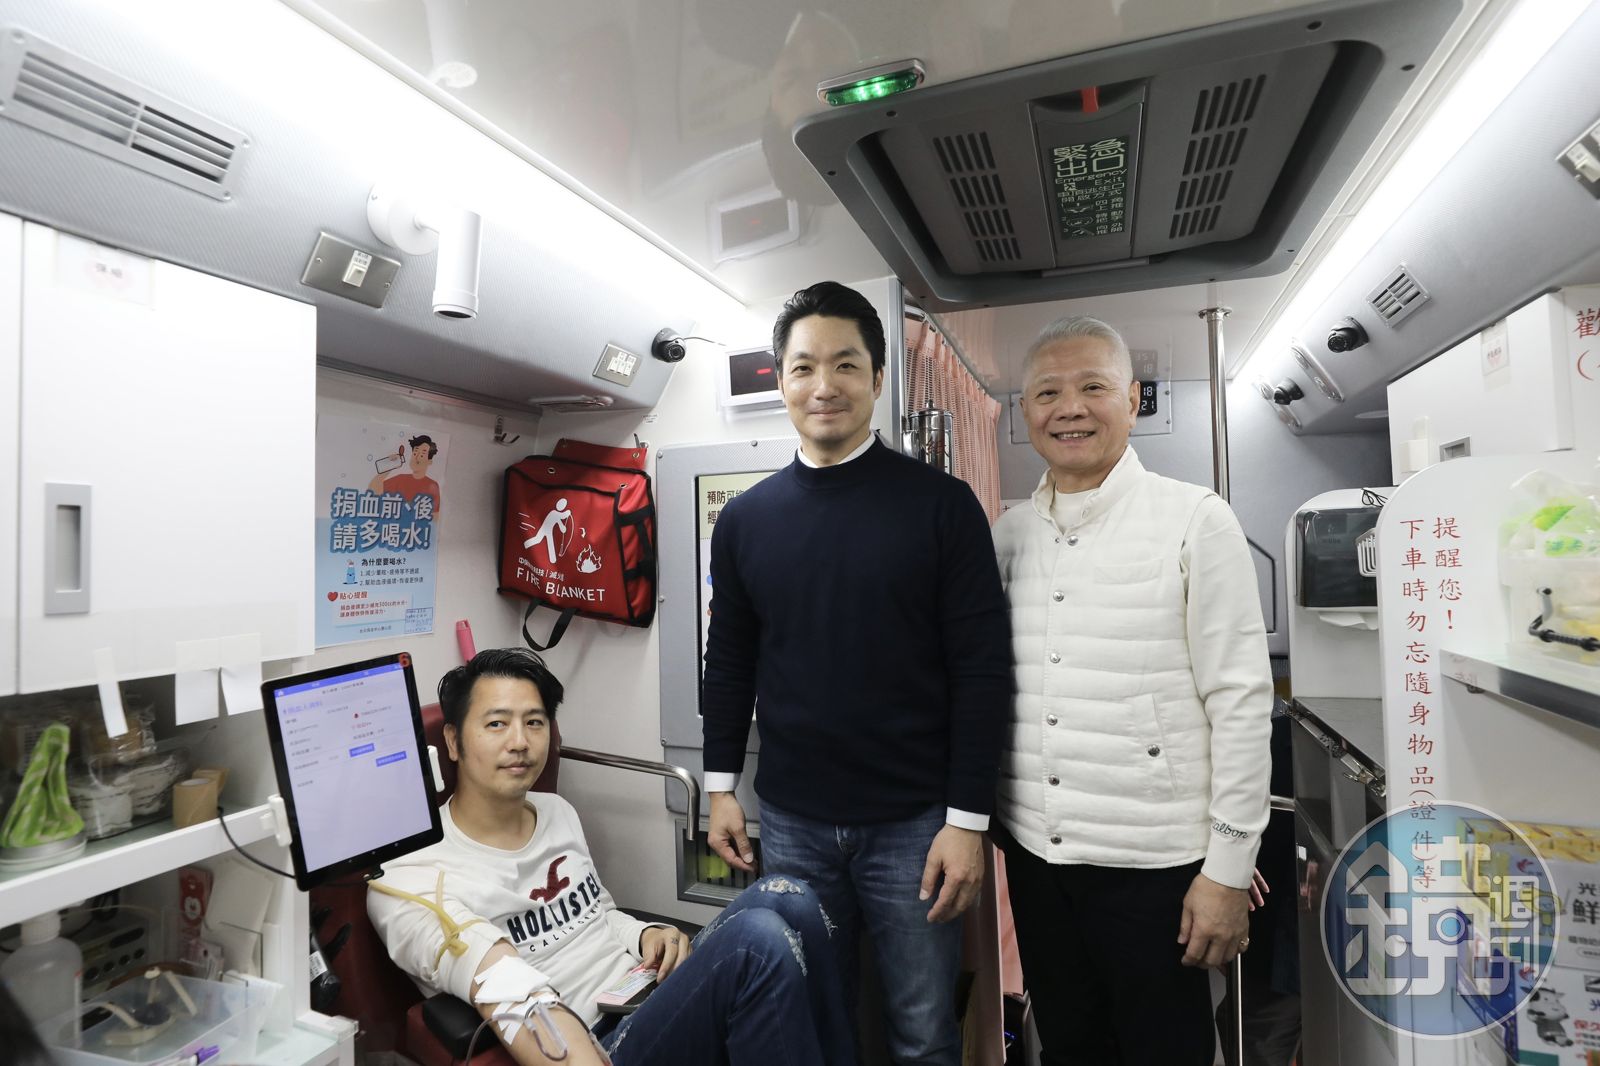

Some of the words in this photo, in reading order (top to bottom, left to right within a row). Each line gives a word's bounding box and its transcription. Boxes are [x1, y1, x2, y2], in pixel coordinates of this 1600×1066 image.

[1053, 138, 1126, 164] 緊急
[1057, 153, 1124, 177] 出口
[1055, 169, 1128, 184] Emergency
[1094, 177, 1122, 186] Exit
[1143, 386, 1153, 397] 18
[333, 489, 433, 520] 捐血前、後
[707, 489, 745, 505] 預防可
[333, 519, 430, 551] 請多喝水!
[361, 557, 407, 567] 為什麼要喝水?
[1432, 517, 1463, 630] 提醒您！
[340, 591, 368, 600] 貼心提醒
[545, 581, 606, 602] BLANKET
[506, 871, 601, 944] HOLLISTE
